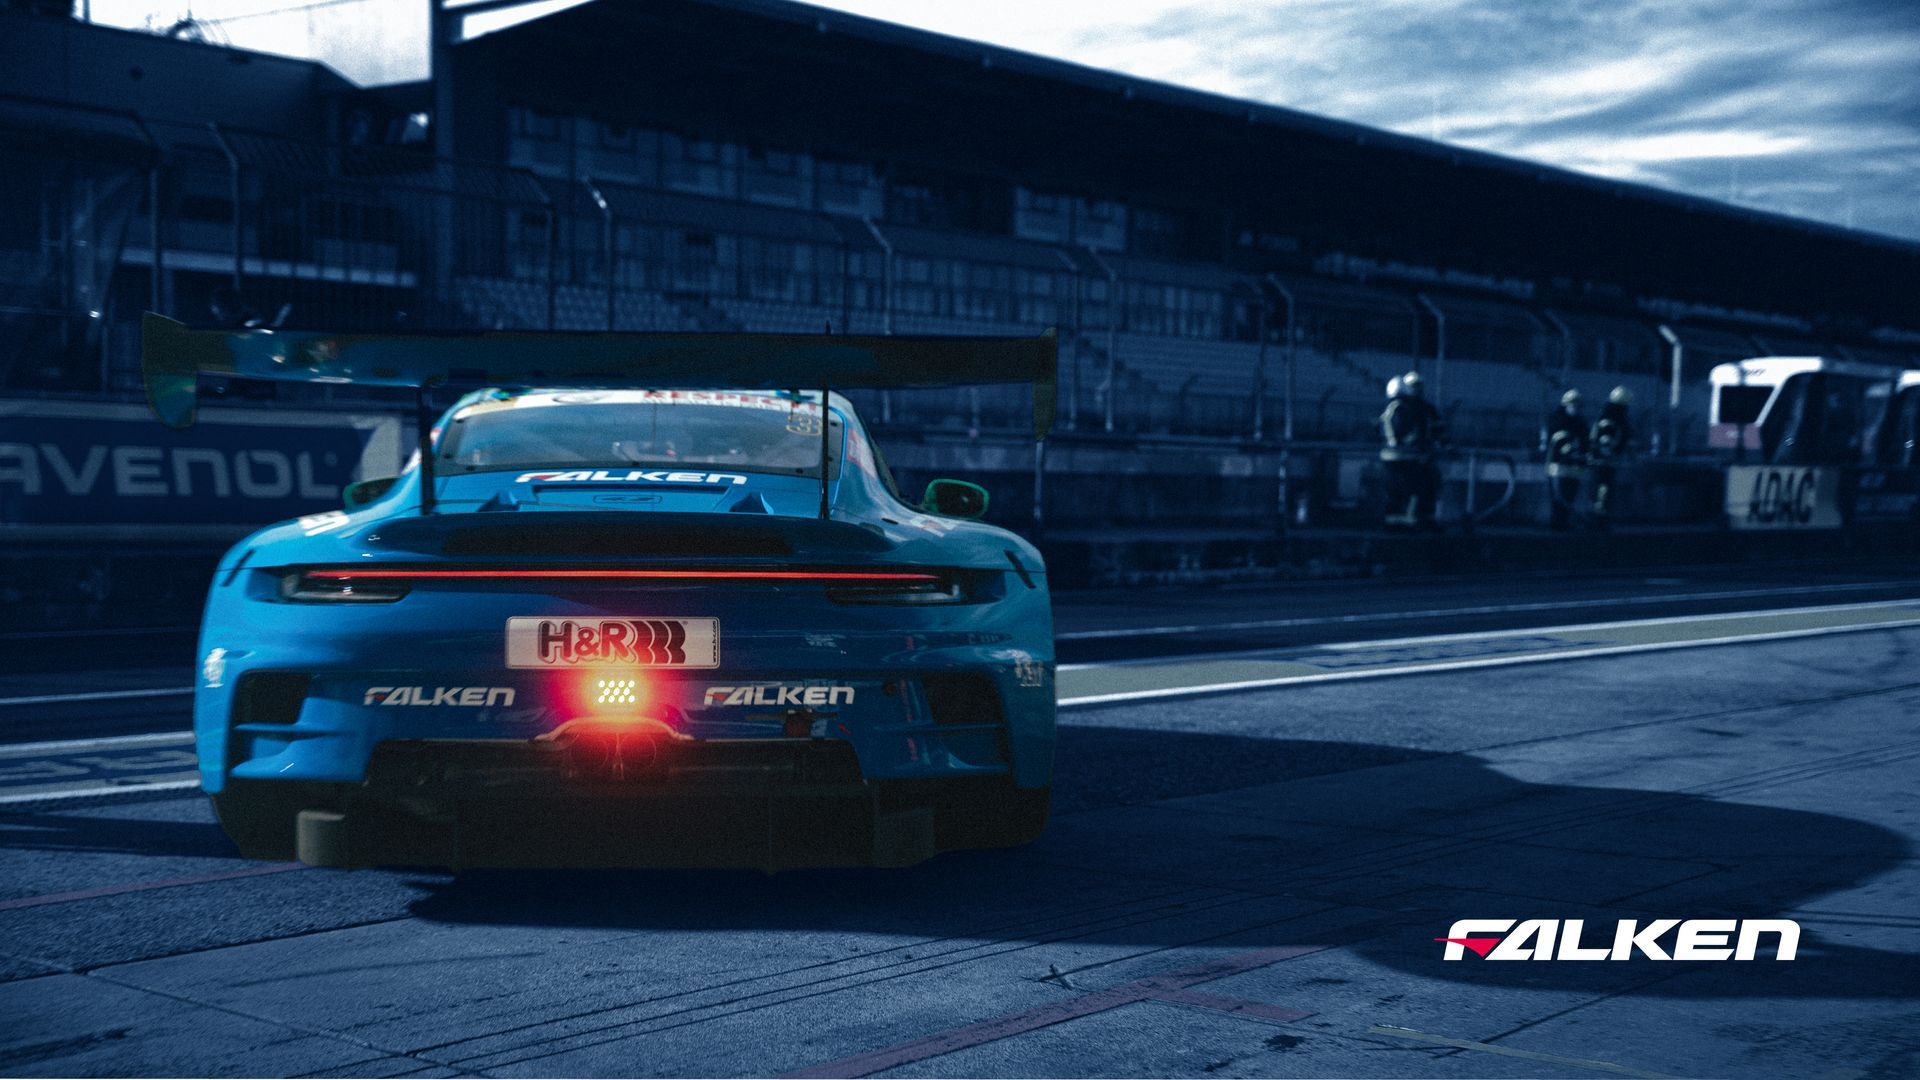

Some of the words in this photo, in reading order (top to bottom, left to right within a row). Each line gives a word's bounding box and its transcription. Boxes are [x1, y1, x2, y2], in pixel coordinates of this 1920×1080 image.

[514, 470, 748, 486] FALKEN
[538, 620, 638, 664] H&R
[363, 686, 516, 707] FALKEN
[703, 686, 855, 706] FALKEN
